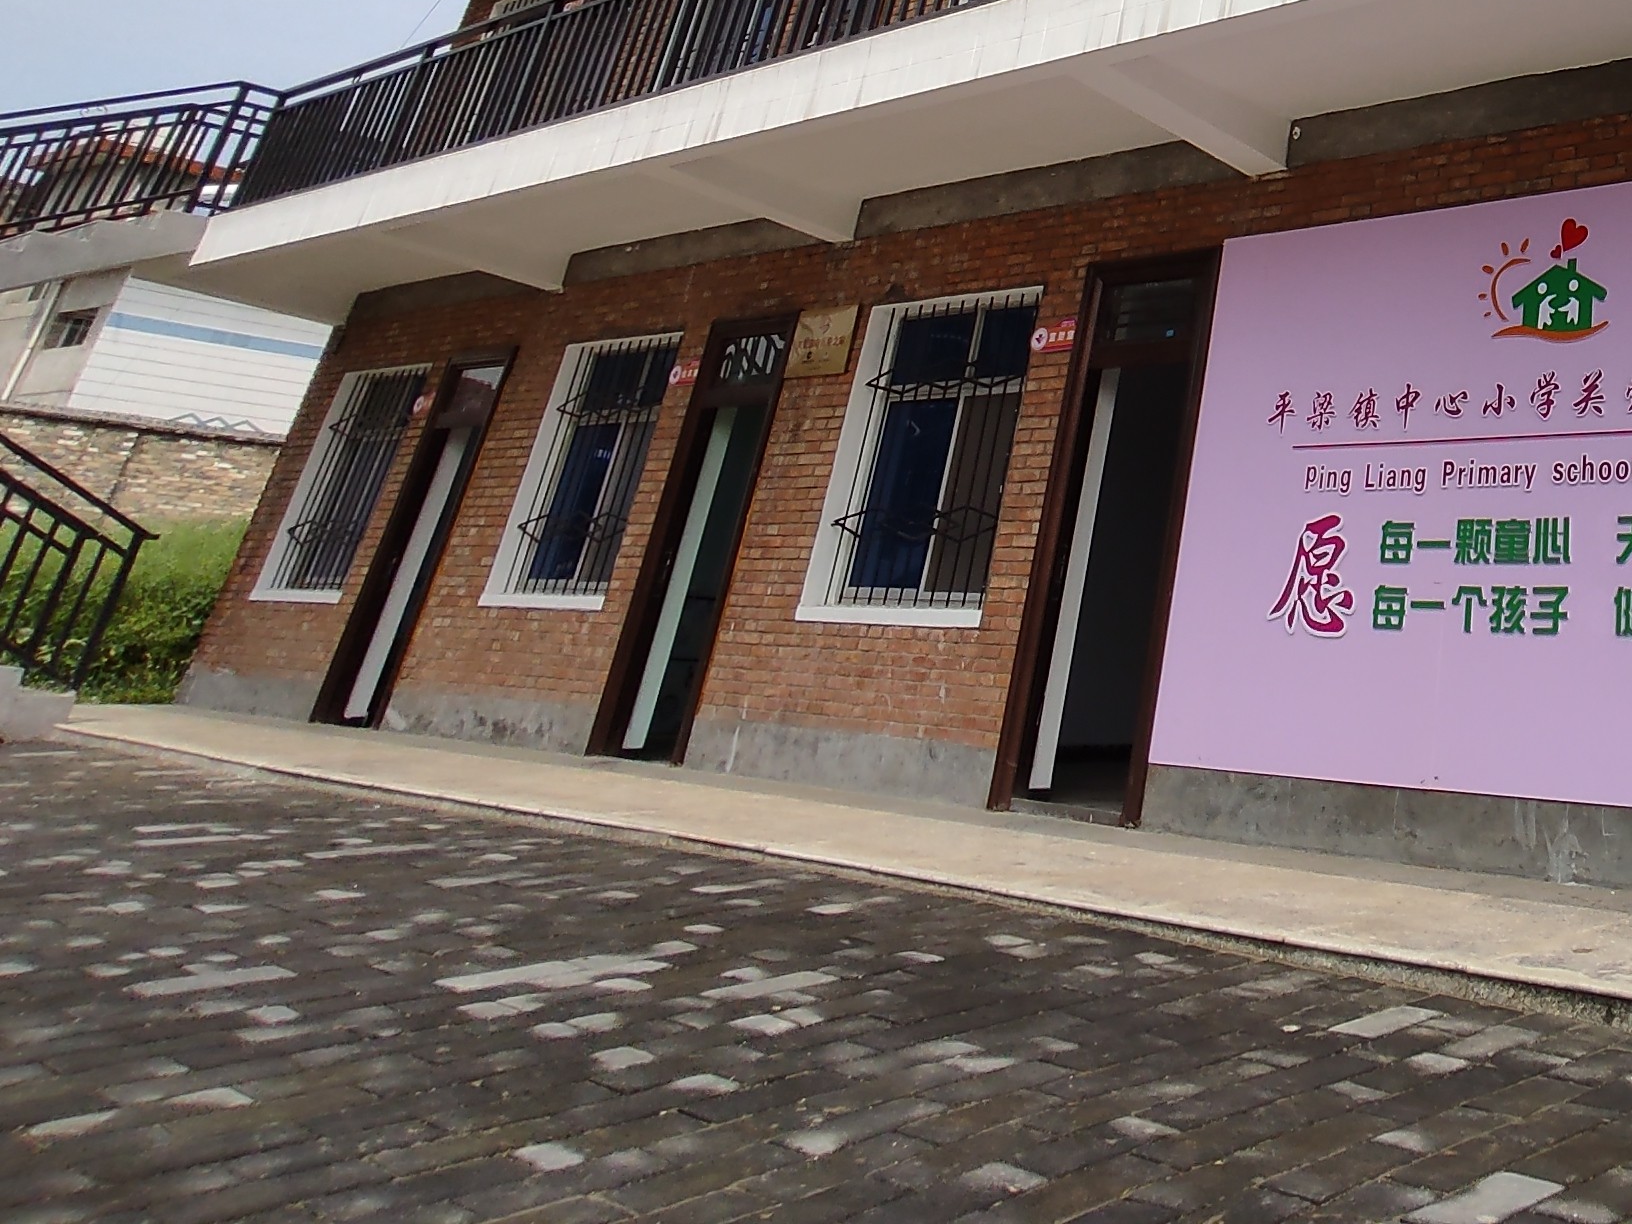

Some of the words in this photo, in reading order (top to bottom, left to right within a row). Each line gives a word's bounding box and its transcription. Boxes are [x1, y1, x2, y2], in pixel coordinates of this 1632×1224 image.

[1304, 464, 1352, 494] Ping
[1364, 463, 1426, 493] Liang
[1442, 460, 1537, 490] Primary
[1380, 518, 1571, 564] 每一颗童心
[1268, 514, 1355, 636] 愿
[1372, 586, 1570, 637] 每一个孩子
